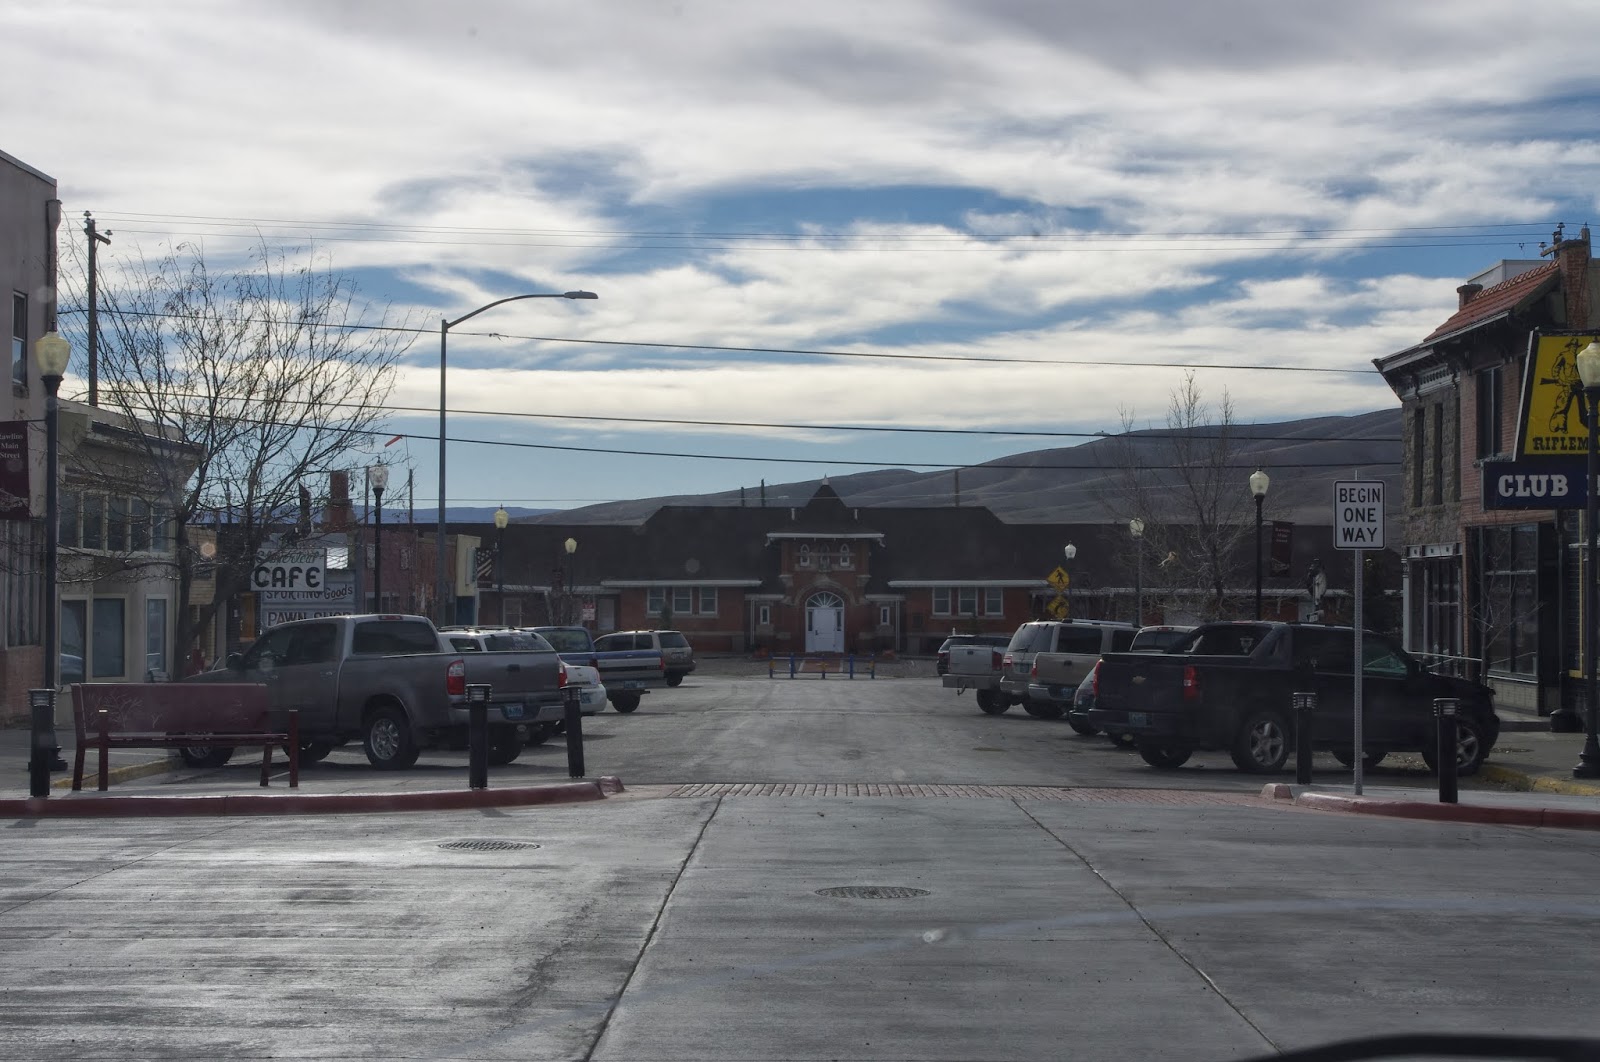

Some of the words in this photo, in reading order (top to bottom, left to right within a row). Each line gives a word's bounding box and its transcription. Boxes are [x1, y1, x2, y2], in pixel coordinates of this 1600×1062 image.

[1533, 437, 1598, 451] RIFLEM
[1498, 474, 1569, 497] CLUB
[1339, 488, 1381, 503] BEGIN
[1344, 507, 1376, 523] ONE
[1342, 527, 1378, 542] WAY
[254, 566, 320, 588] CAFE
[323, 584, 353, 600] Goods
